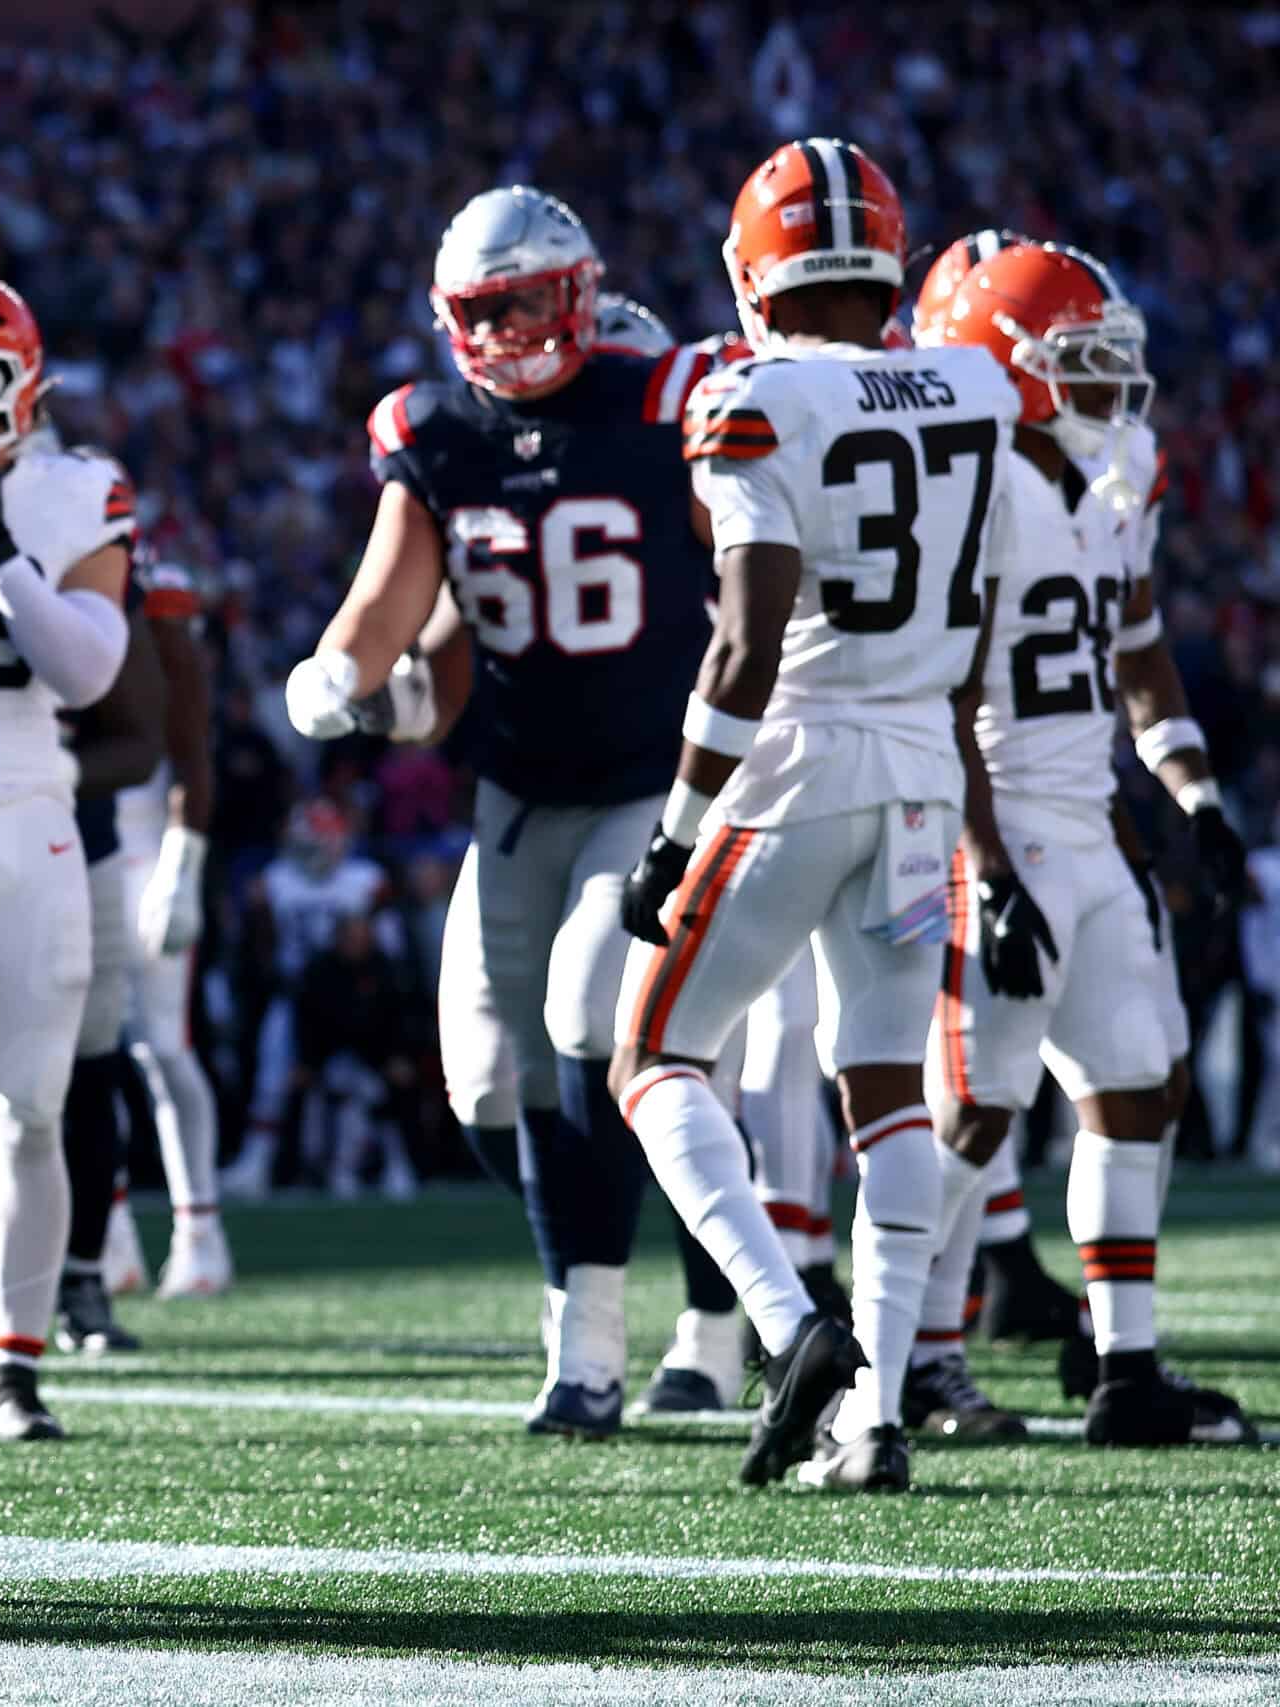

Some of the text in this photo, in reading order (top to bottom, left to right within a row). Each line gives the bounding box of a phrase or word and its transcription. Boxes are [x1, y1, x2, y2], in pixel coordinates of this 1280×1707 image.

[803, 256, 874, 273] CLEVELAND
[854, 370, 956, 412] JONES
[821, 416, 997, 633] 37
[447, 496, 644, 657] 66
